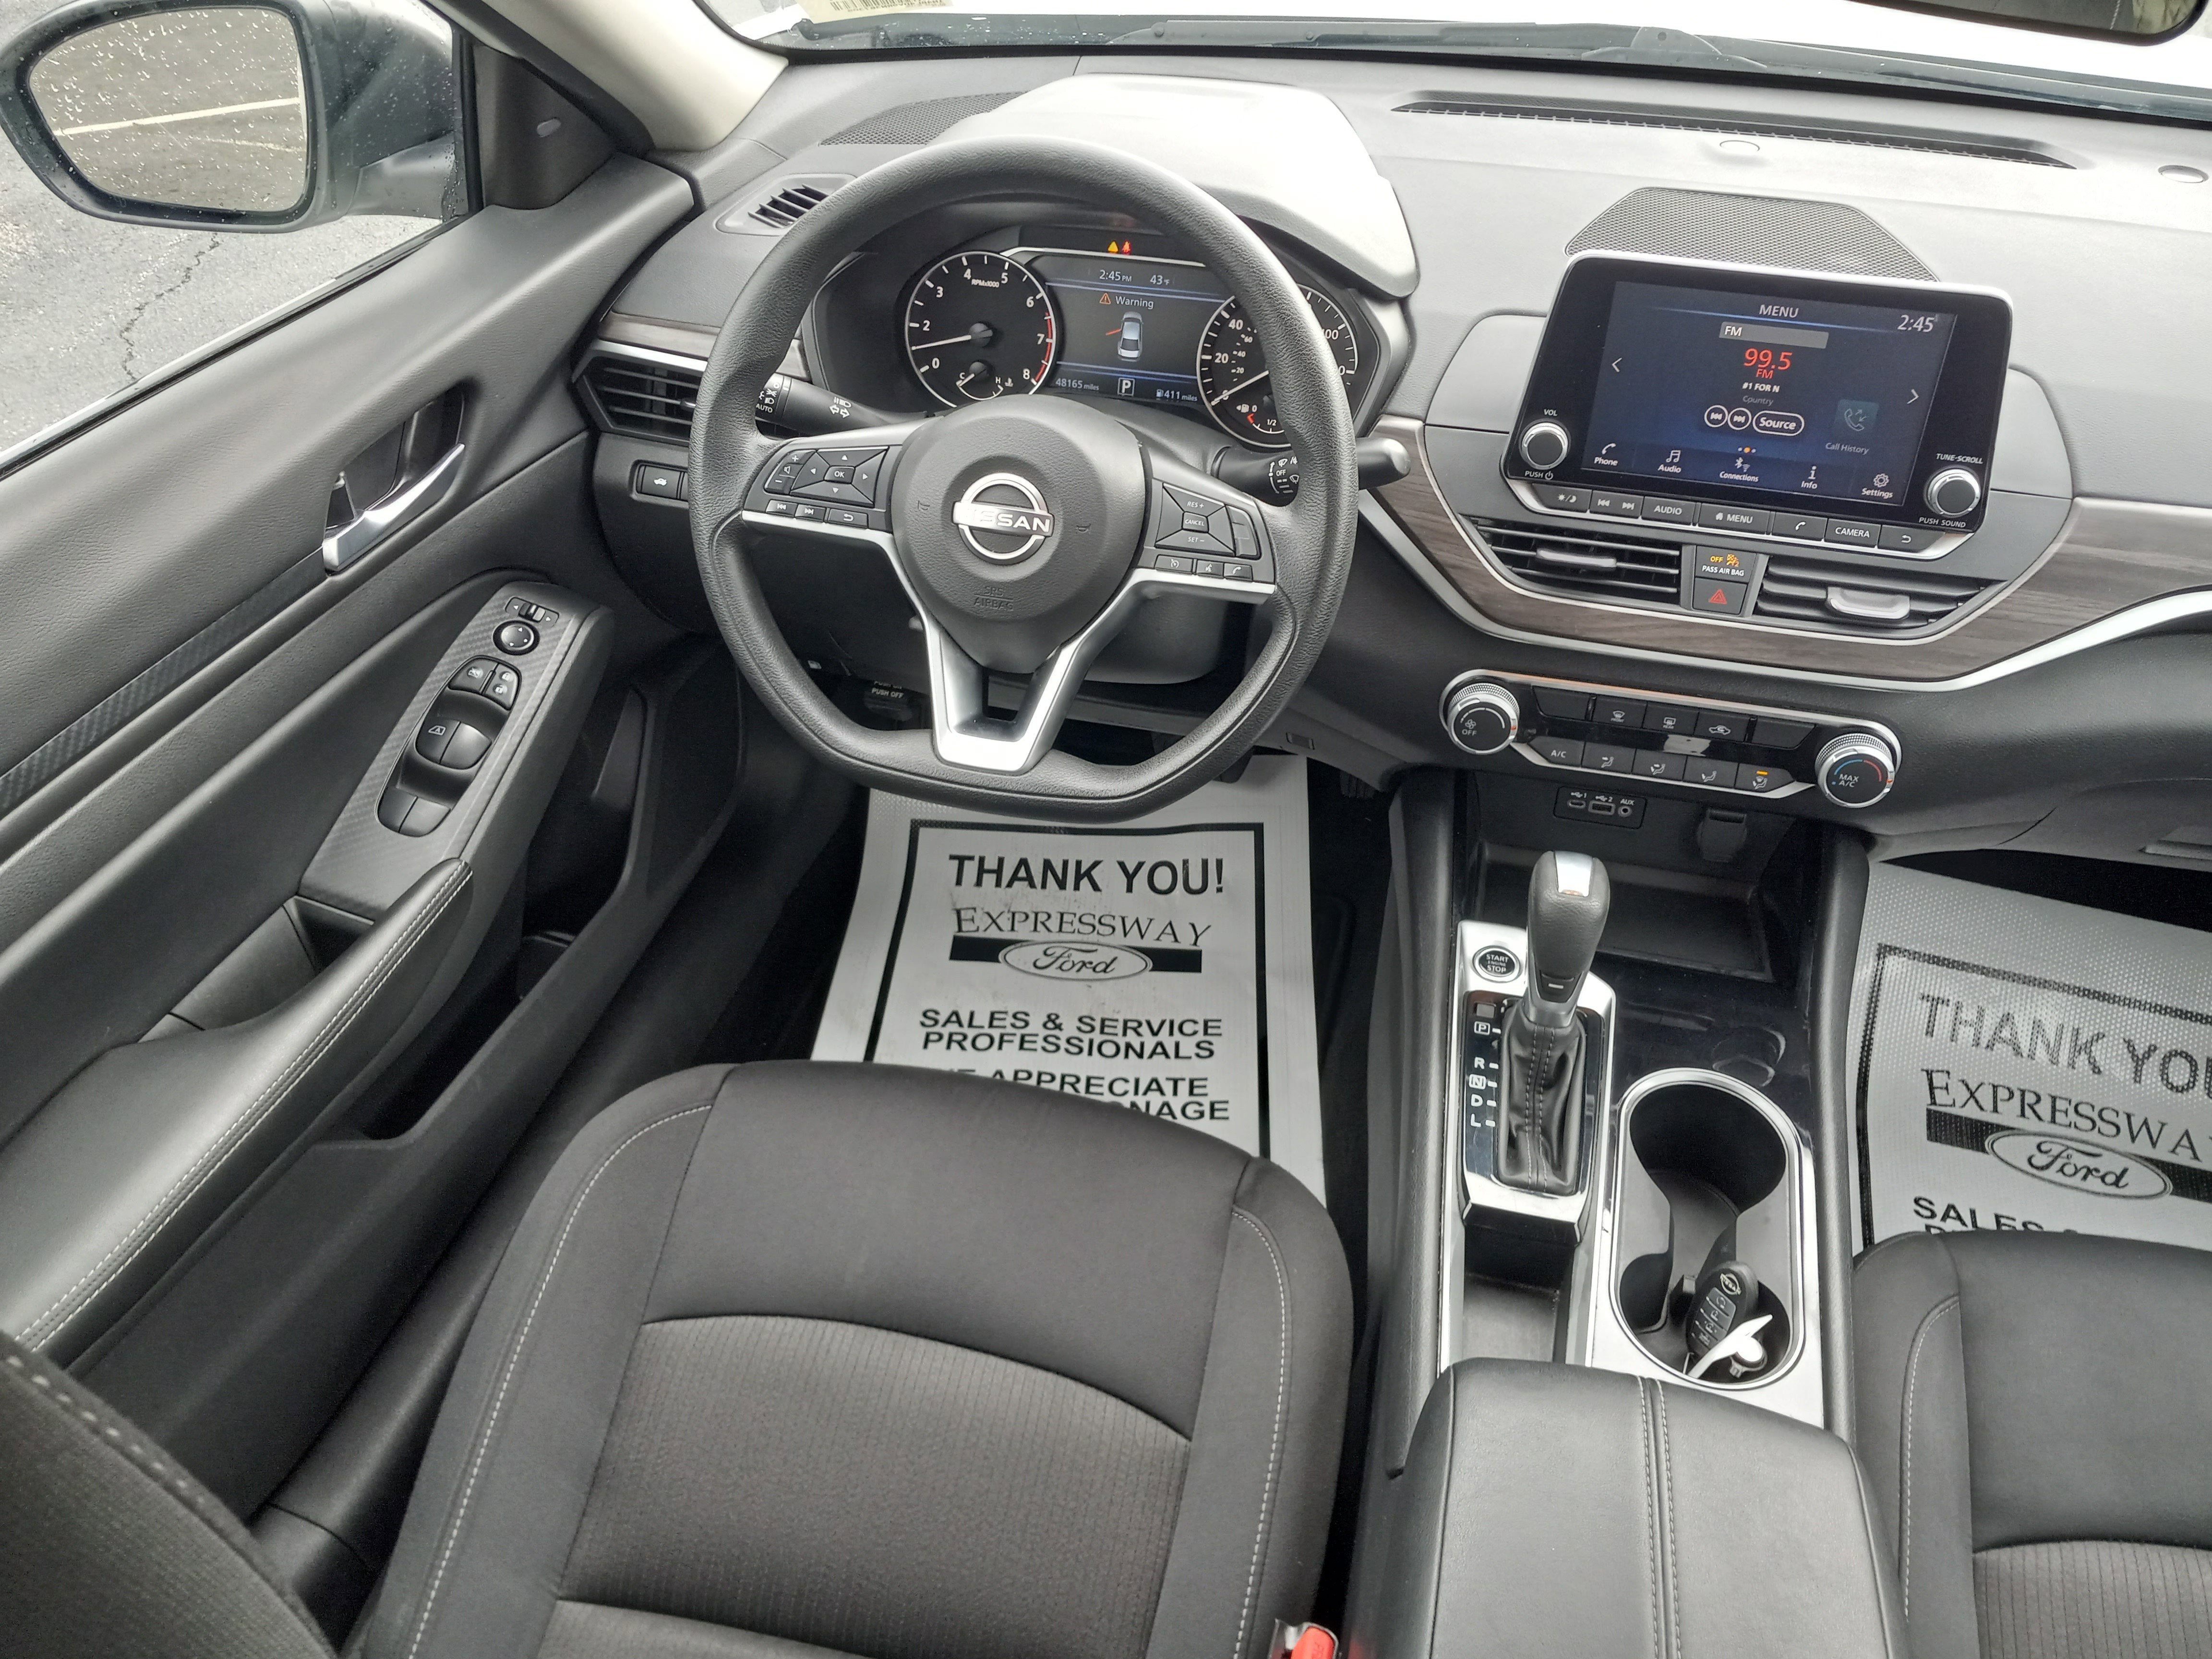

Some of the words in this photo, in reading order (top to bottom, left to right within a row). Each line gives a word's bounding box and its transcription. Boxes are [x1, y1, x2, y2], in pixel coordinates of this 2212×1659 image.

[963, 268, 972, 280] 4
[1001, 272, 1008, 284] 5
[1099, 269, 1121, 281] 2:45
[936, 286, 943, 298] 3
[1026, 296, 1034, 307] 6
[1116, 296, 1154, 310] Warning
[1759, 304, 1799, 318] MENU
[923, 320, 930, 331] 2
[1228, 319, 1243, 330] 40
[1897, 314, 1934, 333] 2:45
[1322, 328, 1339, 340] 00
[1724, 325, 1742, 337] FM
[1037, 333, 1045, 345] 7
[932, 358, 939, 369] 0
[1214, 353, 1229, 363] 20
[1743, 347, 1792, 370] 99.5
[1023, 368, 1030, 380] 8
[1756, 369, 1774, 379] FM
[1056, 378, 1083, 389] 48165
[1121, 380, 1131, 393] P
[1754, 383, 1771, 392] FOR
[1164, 390, 1180, 399] 411
[1743, 395, 1774, 406] Country
[756, 403, 773, 413] AUTO
[1759, 417, 1796, 430] Source
[1825, 442, 1840, 451] Call
[1841, 444, 1869, 455] History
[1594, 457, 1618, 466] Phone
[1936, 453, 1983, 464] TUNE-SCROLL
[1658, 464, 1682, 473] Audio
[1719, 471, 1759, 482] Connections
[1801, 481, 1817, 490] Info
[1862, 487, 1893, 499] Settings
[1654, 505, 1682, 515] AUDIO
[1727, 513, 1753, 524] MENU
[1941, 519, 1966, 528] SOUND
[1835, 527, 1870, 538] CAMERA
[872, 687, 890, 696] PUSH
[1551, 750, 1566, 758] A/C
[1839, 774, 1859, 782] MAX
[949, 853, 1103, 892] THANK
[1117, 858, 1224, 895] YOU!
[1033, 945, 1117, 975] Ford
[1486, 954, 1509, 962] START
[1487, 965, 1506, 973] STOP
[919, 1009, 1029, 1030] SALES
[1042, 1013, 1063, 1032] &
[1076, 1016, 1223, 1038] SERVICE
[1479, 1024, 1487, 1032] P
[922, 1031, 1215, 1059] PROFESSIONALS
[1919, 992, 2106, 1075] THANK
[2122, 1036, 2212, 1100] YO
[1474, 1057, 1485, 1069] R
[1471, 1094, 1483, 1106] D
[1470, 1114, 1481, 1127] L
[1921, 1068, 2212, 1163] EXPRESSWA
[2027, 1140, 2130, 1190] Ford
